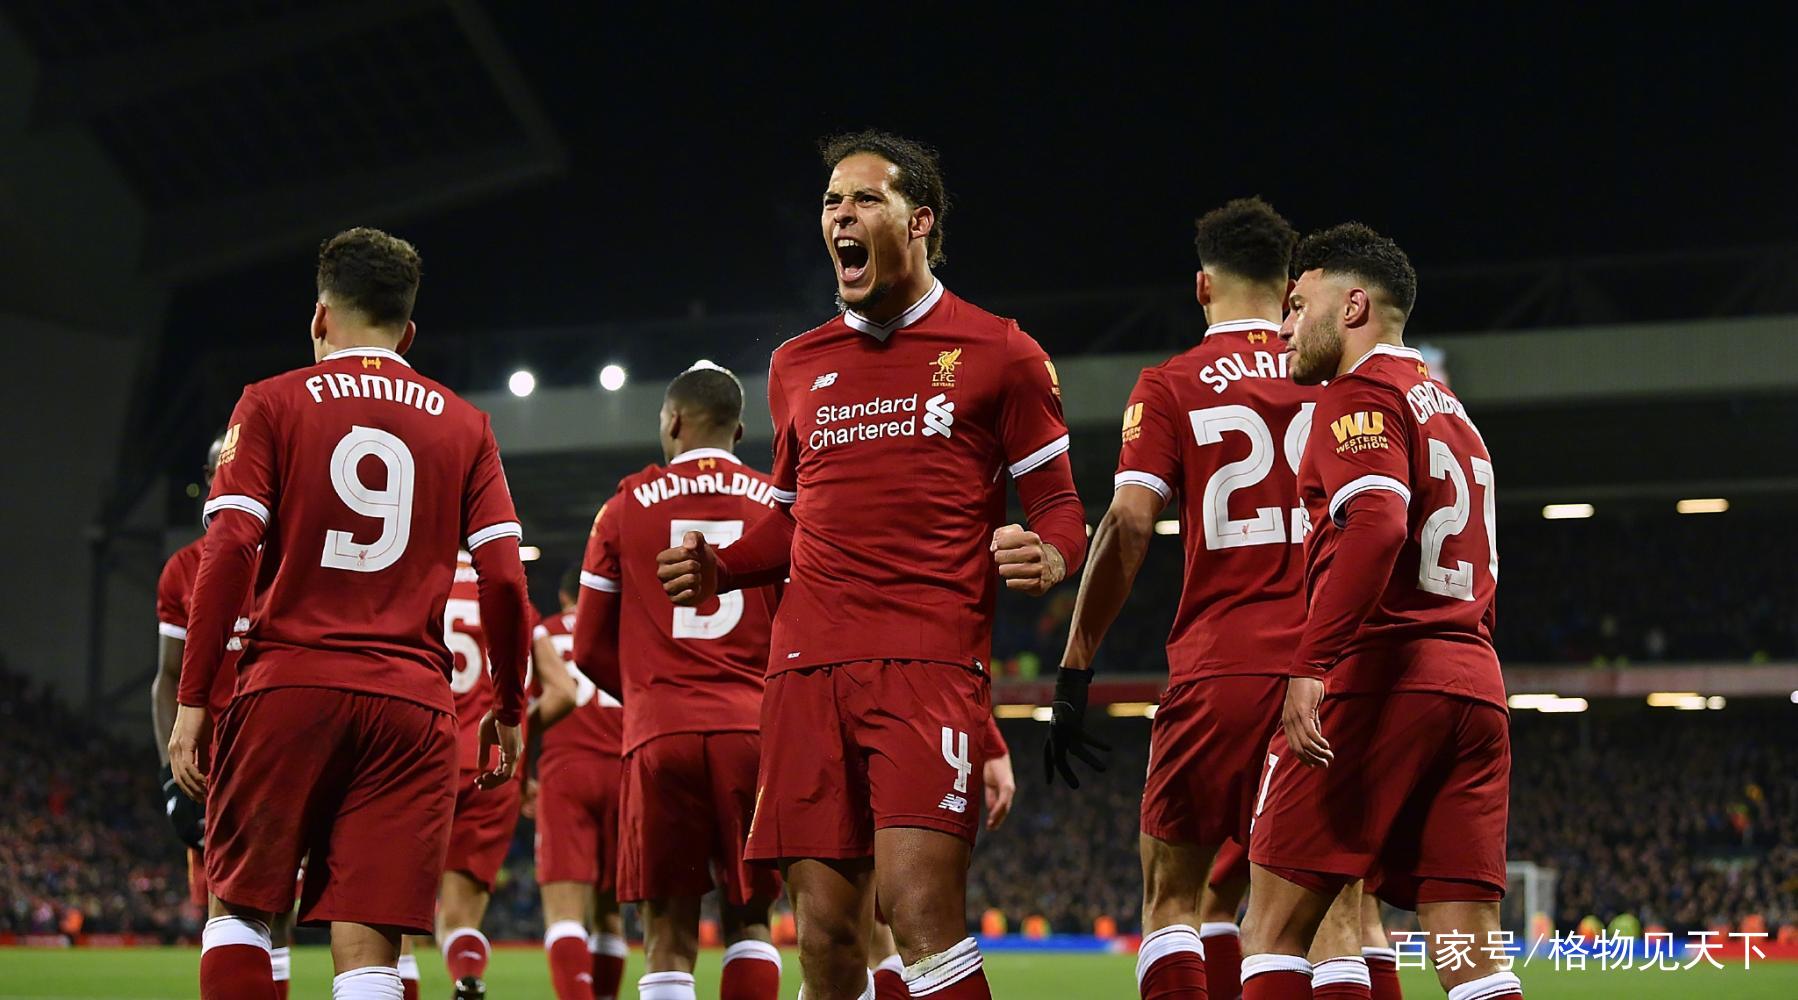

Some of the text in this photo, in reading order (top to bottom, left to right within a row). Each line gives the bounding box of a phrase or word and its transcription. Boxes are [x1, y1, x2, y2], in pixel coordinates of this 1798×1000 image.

[305, 373, 446, 416] FIRMINO
[815, 393, 918, 425] Standard
[809, 416, 916, 451] Chartered
[1330, 411, 1384, 444] WU
[1336, 435, 1388, 454] WESTERN
[1351, 441, 1389, 454] UNION
[320, 425, 415, 573] 9
[670, 519, 745, 640] 5
[941, 726, 972, 794] 4
